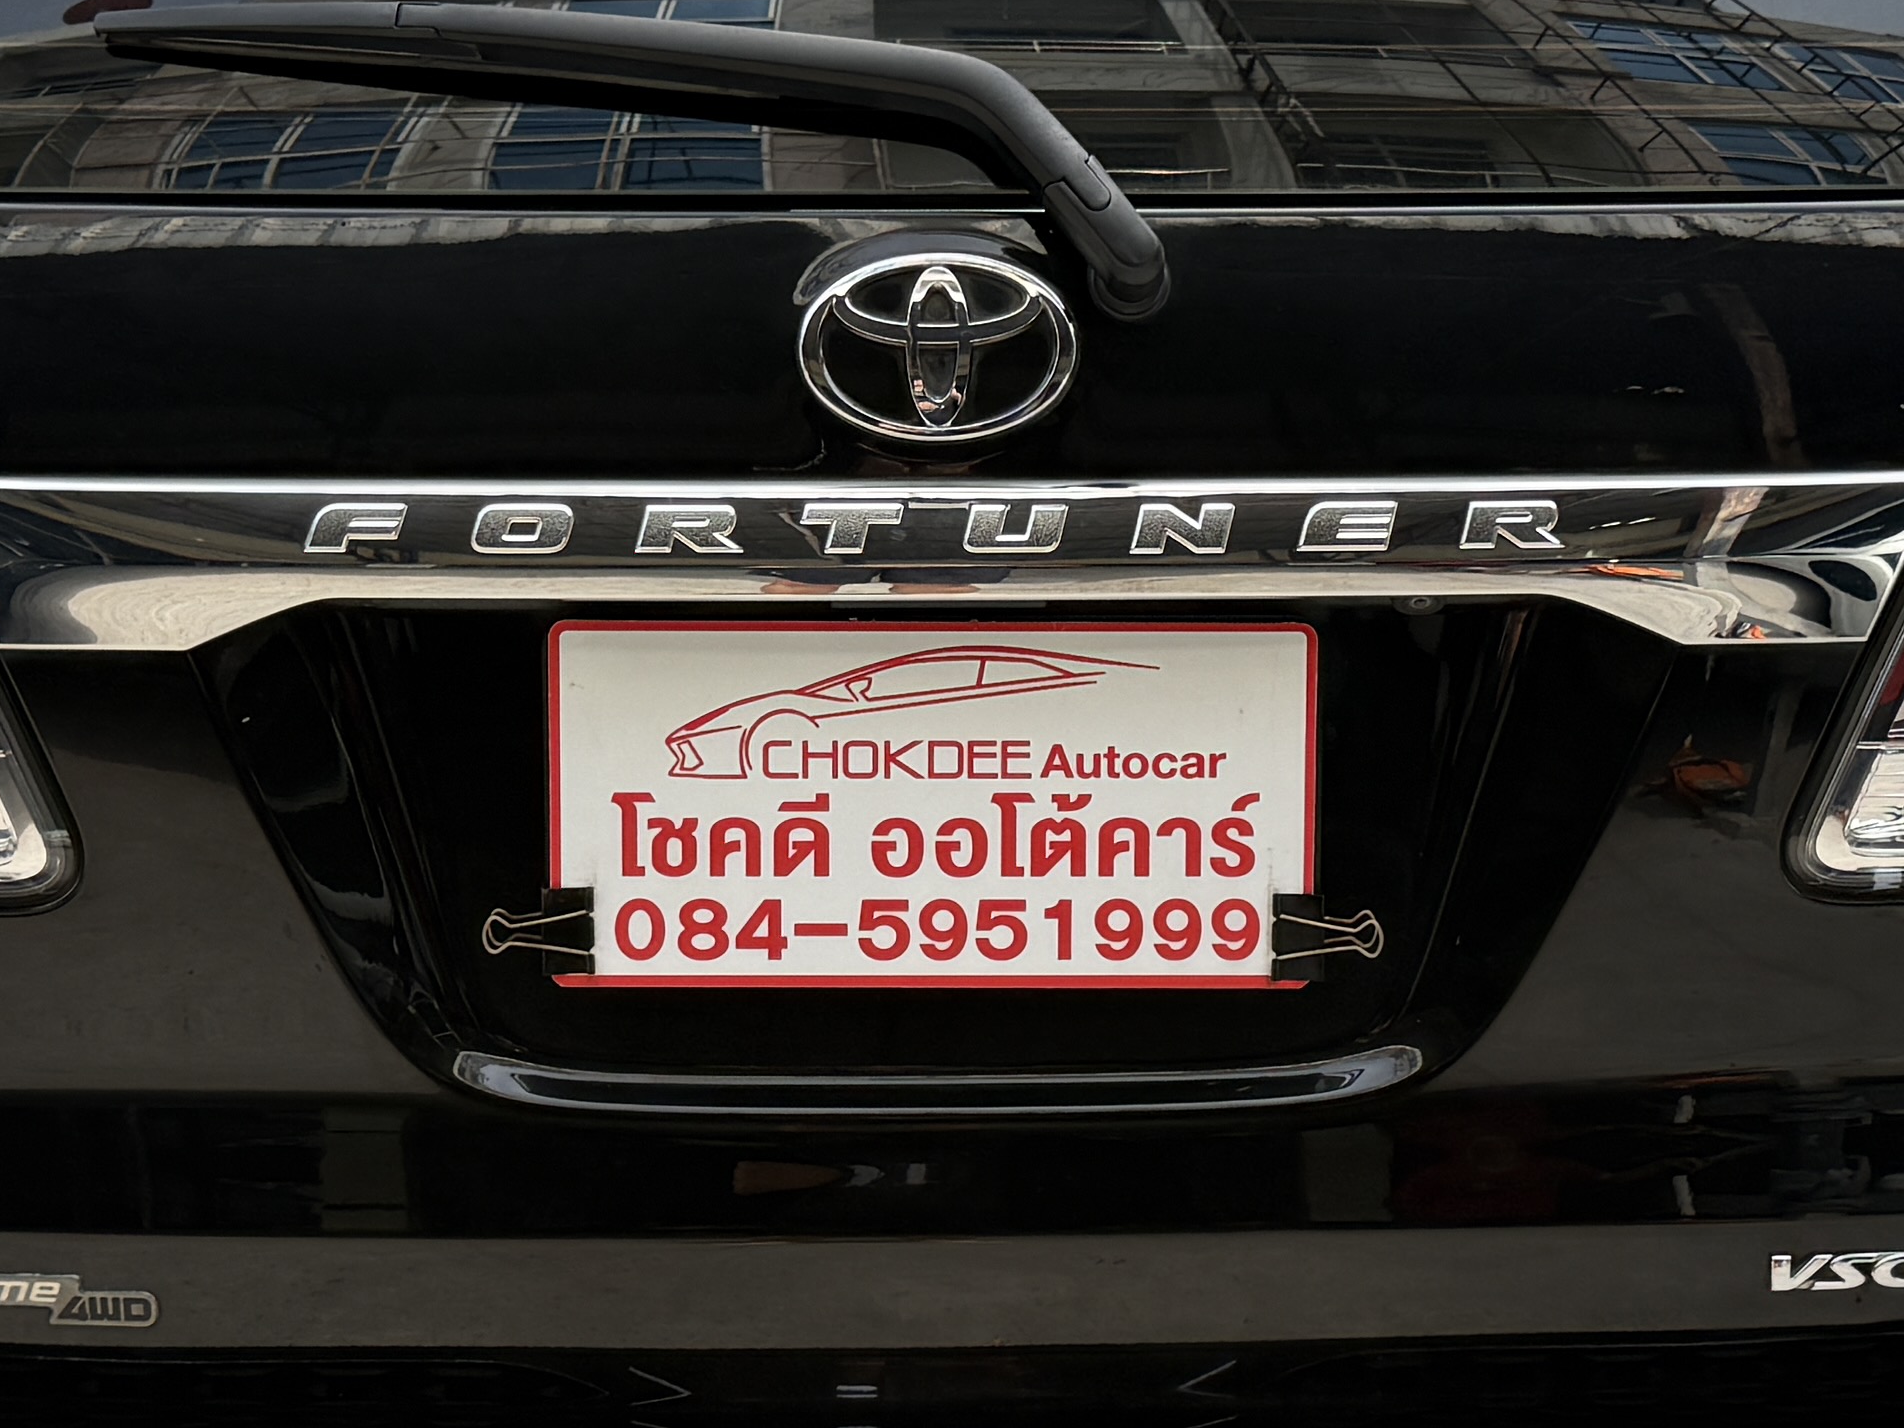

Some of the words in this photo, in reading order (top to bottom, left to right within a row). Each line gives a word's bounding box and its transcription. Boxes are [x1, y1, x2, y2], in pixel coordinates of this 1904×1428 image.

[301, 499, 1564, 557] FORTUNER
[761, 739, 1033, 780] CHOKDEE
[1039, 742, 1227, 780] Autocar
[610, 792, 832, 879] โชคดี
[870, 792, 1260, 879] ออโต้คาร์
[613, 897, 1262, 963] 084-5951999
[55, 1294, 148, 1323] 4WD
